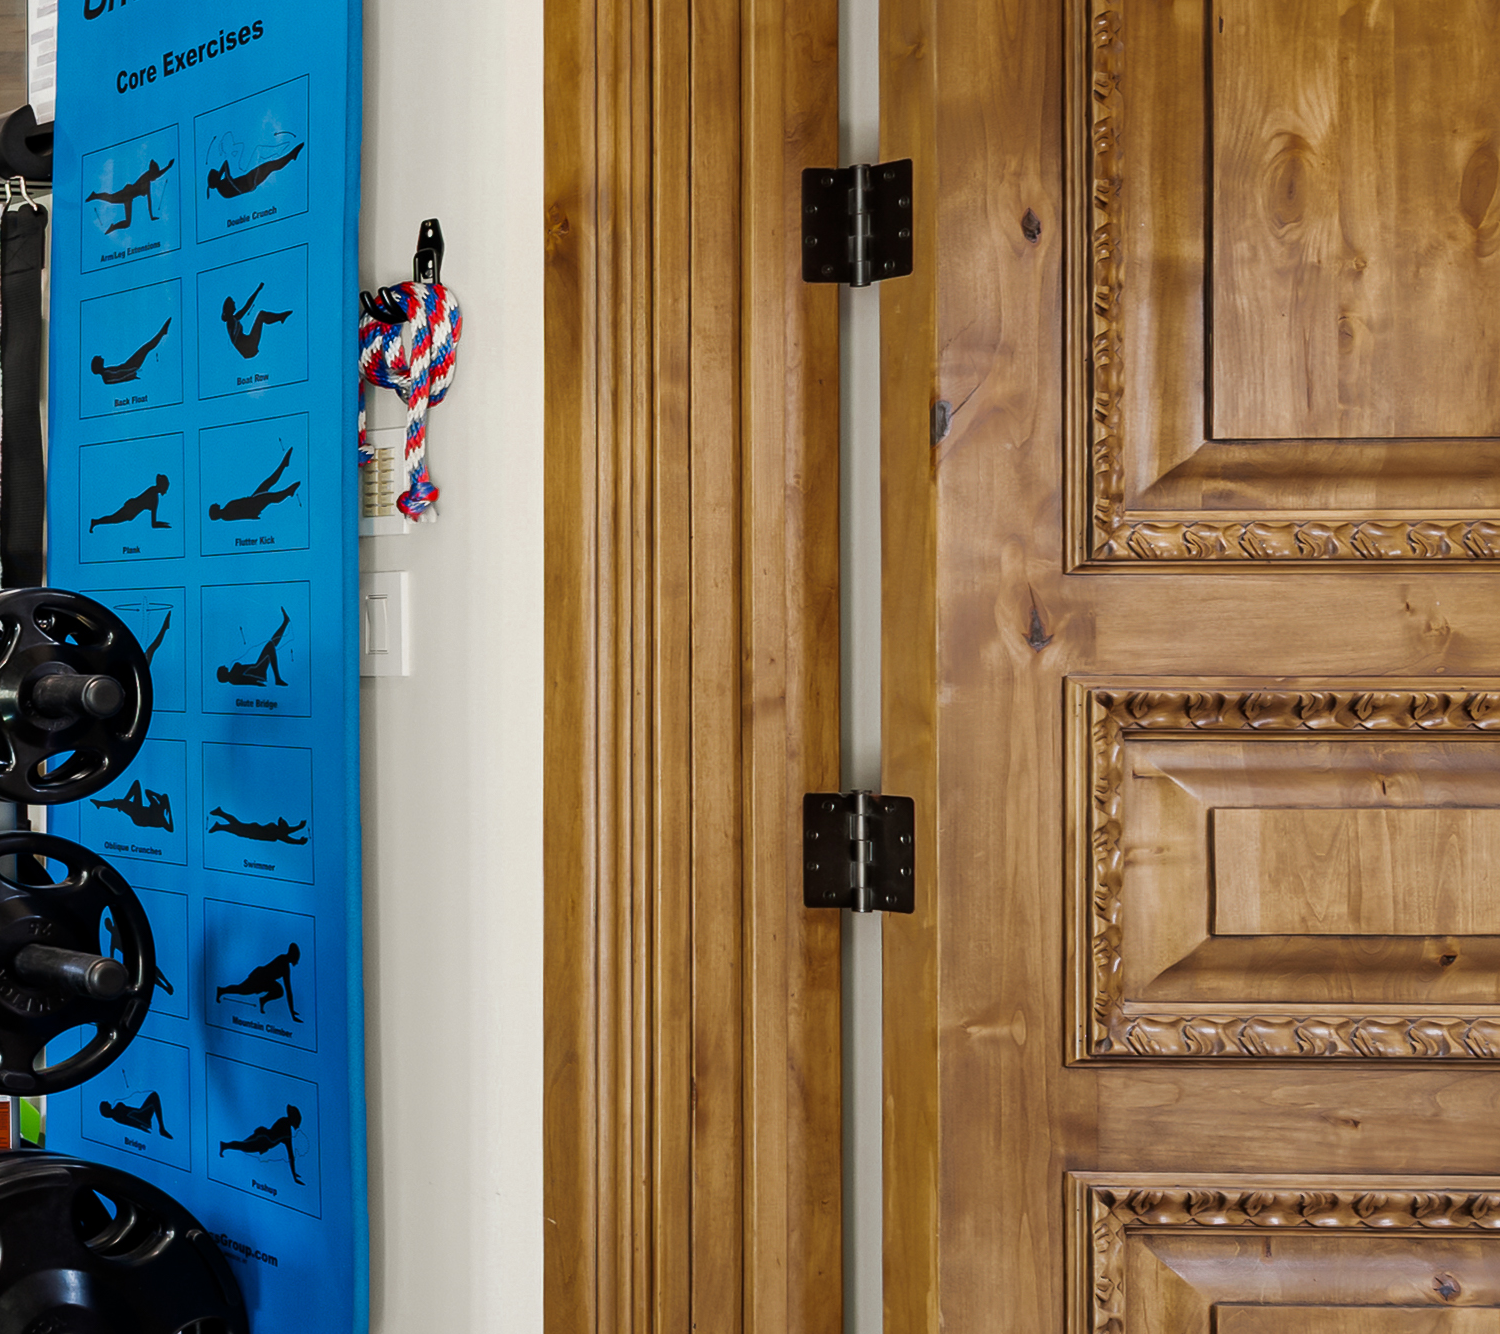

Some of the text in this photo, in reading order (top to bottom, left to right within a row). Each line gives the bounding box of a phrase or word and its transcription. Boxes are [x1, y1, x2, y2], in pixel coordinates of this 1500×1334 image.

[116, 19, 264, 94] Core Exercises
[227, 206, 277, 228] Double Crunch
[127, 241, 161, 257] Extensions
[237, 373, 269, 386] Boat Row
[114, 394, 148, 407] Back Float
[235, 535, 275, 547] Flutter Kick
[122, 546, 141, 555] Plank
[235, 698, 278, 710] Glute Bridge
[104, 841, 162, 856] Oblique Crunches
[243, 859, 275, 872] Swimmer
[232, 1016, 293, 1039] Mountain Climber
[124, 1136, 146, 1151] Bridge
[252, 1178, 278, 1197] Pushup
[208, 1231, 278, 1267] sGroup.com
